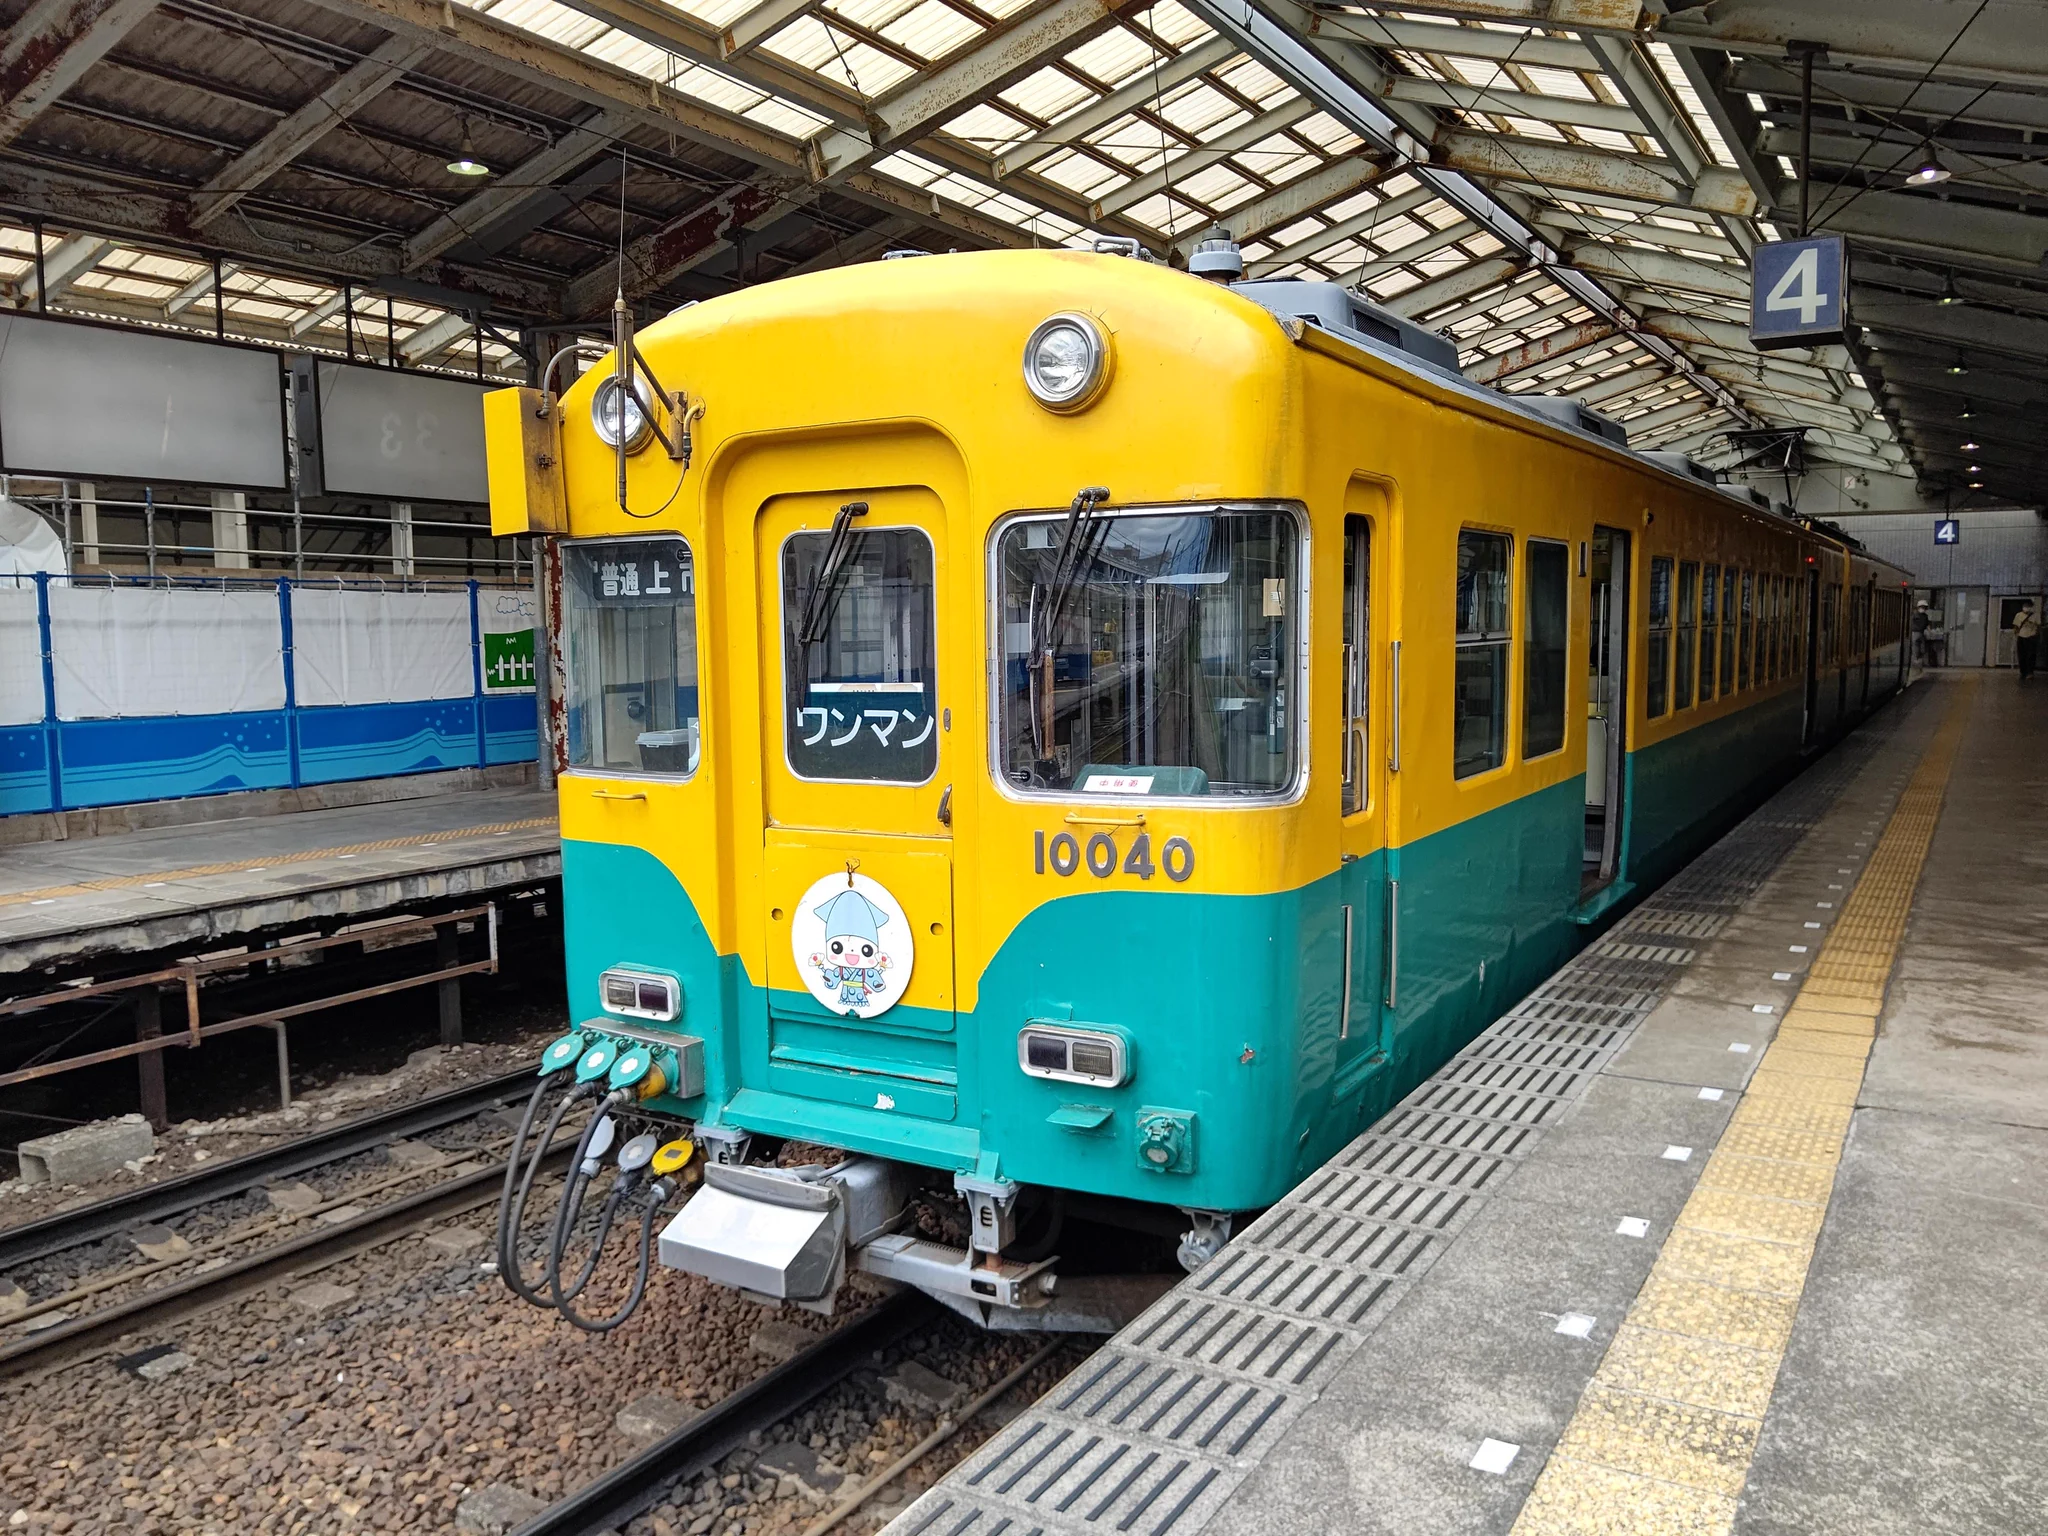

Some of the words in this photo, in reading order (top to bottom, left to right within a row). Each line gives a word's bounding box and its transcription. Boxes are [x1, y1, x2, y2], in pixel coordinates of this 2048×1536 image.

[1766, 248, 1828, 324] 4
[1938, 522, 1955, 542] 4
[601, 562, 640, 596] 普通
[796, 706, 934, 748] ワンマン
[1034, 829, 1195, 882] 10040
